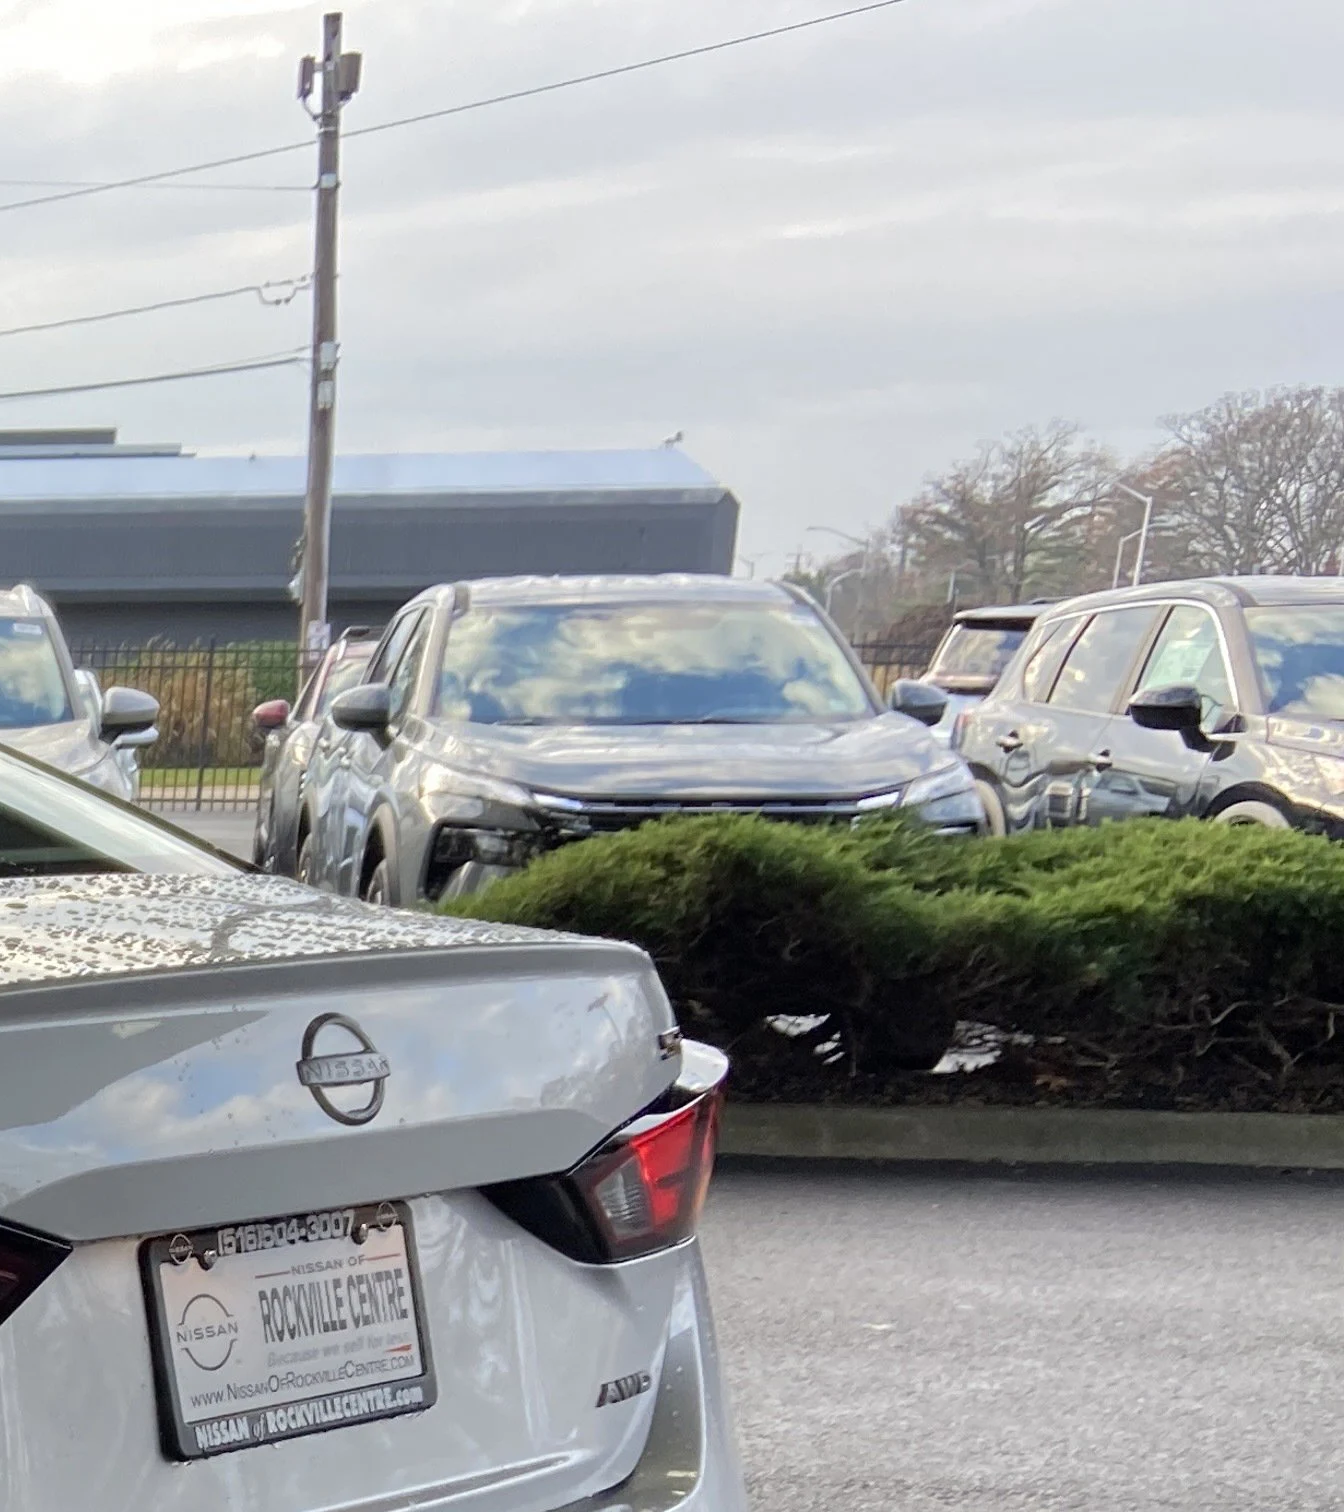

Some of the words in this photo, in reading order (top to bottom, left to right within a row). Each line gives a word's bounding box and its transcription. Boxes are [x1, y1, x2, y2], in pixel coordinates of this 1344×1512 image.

[304, 1054, 390, 1081] NISSAN
[291, 1258, 343, 1276] NISSAN
[347, 1254, 366, 1270] OF
[258, 1277, 347, 1344] ROCKVILLE
[346, 1268, 409, 1328] CENTRE
[176, 1321, 238, 1343] NISSAN
[595, 1369, 652, 1408] AWD
[195, 1415, 249, 1450] NISSAN
